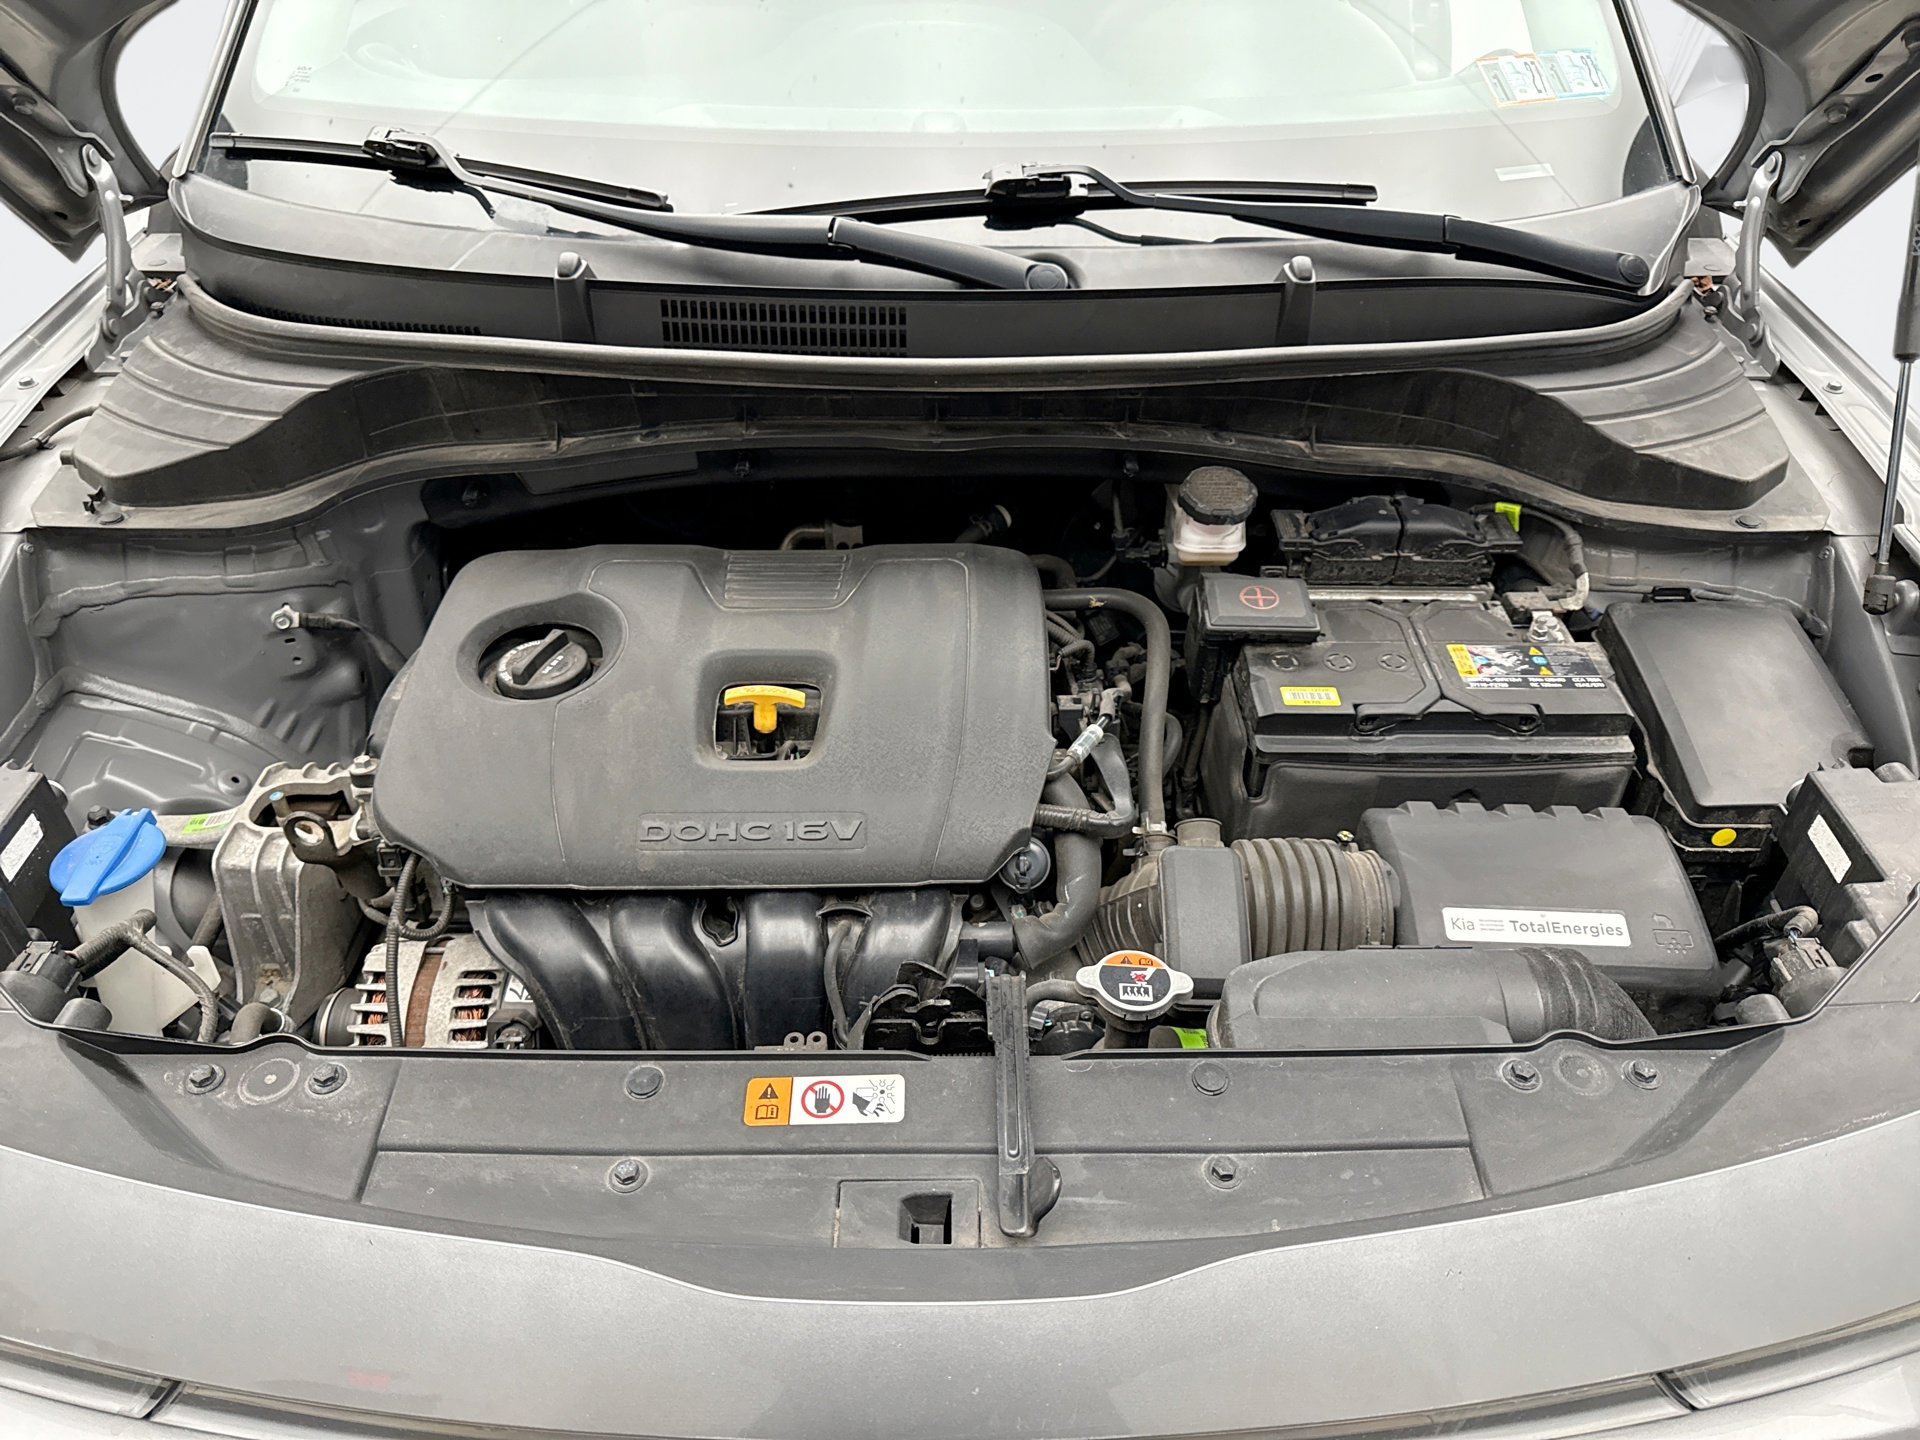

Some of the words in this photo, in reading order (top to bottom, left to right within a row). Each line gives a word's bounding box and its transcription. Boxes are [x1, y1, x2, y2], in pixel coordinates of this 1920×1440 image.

[640, 820, 772, 842] DOHC
[784, 820, 863, 842] 16V
[1451, 917, 1475, 931] Kia
[1509, 919, 1624, 937] TotalEnergies
